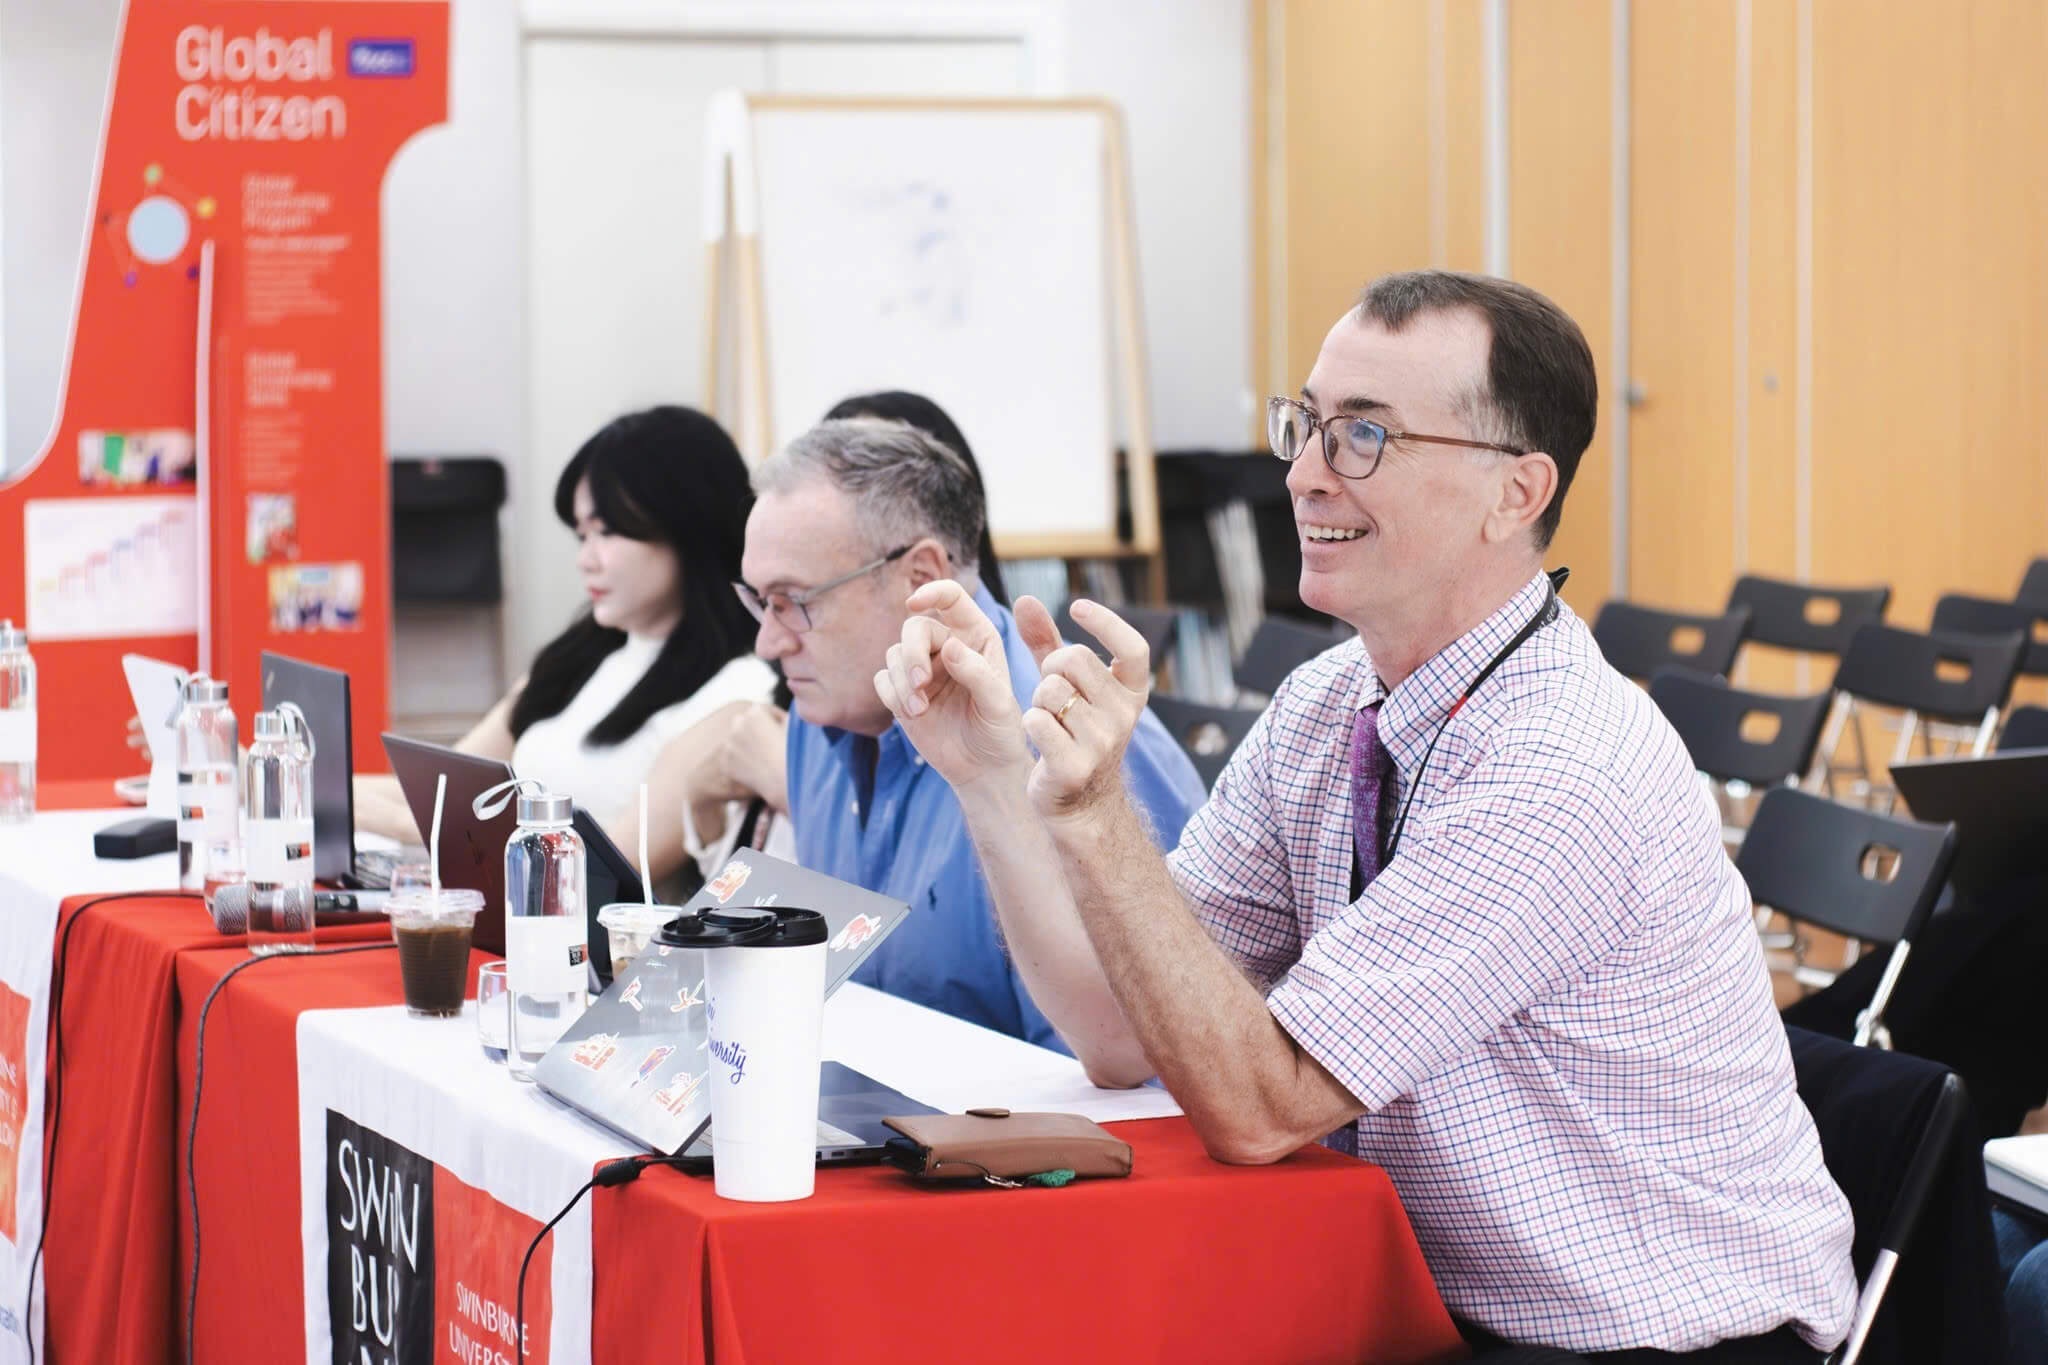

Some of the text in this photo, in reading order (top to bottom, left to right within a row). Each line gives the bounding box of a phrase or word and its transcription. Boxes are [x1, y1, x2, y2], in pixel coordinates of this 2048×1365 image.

[175, 24, 333, 82] Global
[175, 84, 347, 141] Citizen
[339, 1139, 420, 1273] SWIN
